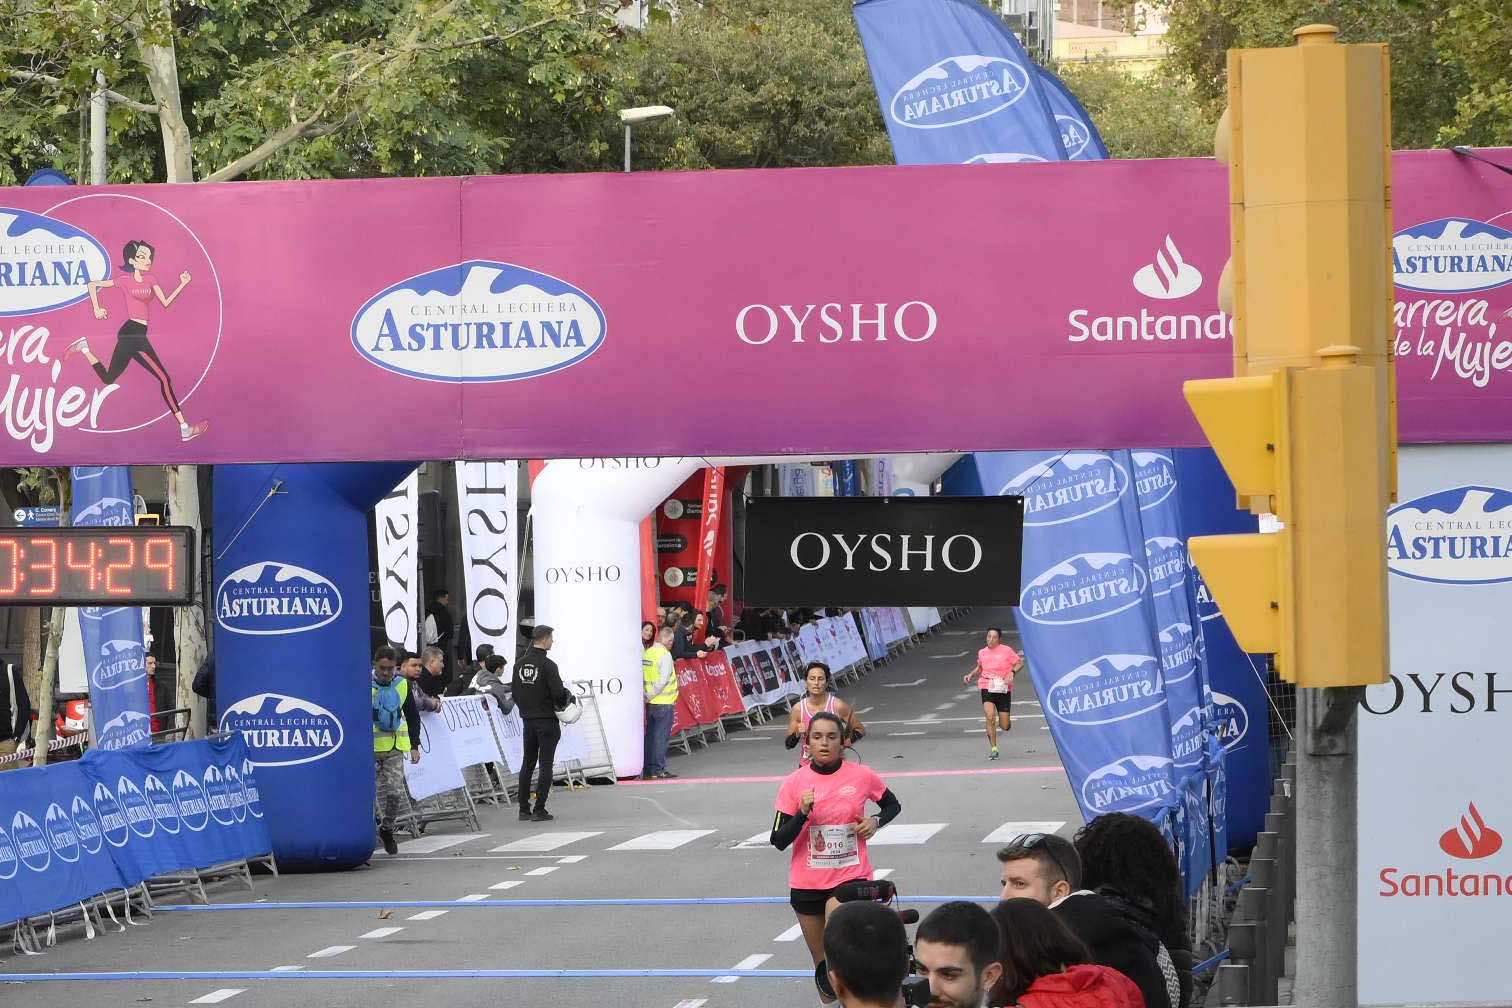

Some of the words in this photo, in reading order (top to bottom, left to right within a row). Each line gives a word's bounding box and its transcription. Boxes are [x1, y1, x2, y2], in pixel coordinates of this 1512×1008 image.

[14, 243, 87, 255] LECHERA
[1407, 244, 1458, 252] CENTRAL
[410, 304, 488, 316] CENTRAL
[496, 302, 578, 315] LECHERA
[1394, 298, 1489, 327] arrera
[371, 307, 587, 353] ASTURIANA
[735, 301, 938, 344] OYSHO
[1417, 328, 1434, 355] la
[1415, 520, 1482, 531] CENTRAL
[789, 532, 983, 573] OYSHO
[546, 565, 621, 584] OYSHO
[233, 587, 276, 595] CENTRAL
[280, 586, 328, 594] LECHERA
[220, 592, 333, 618] ASTURIANA
[234, 720, 275, 728] CENTRAL
[278, 718, 329, 726] LECHERA
